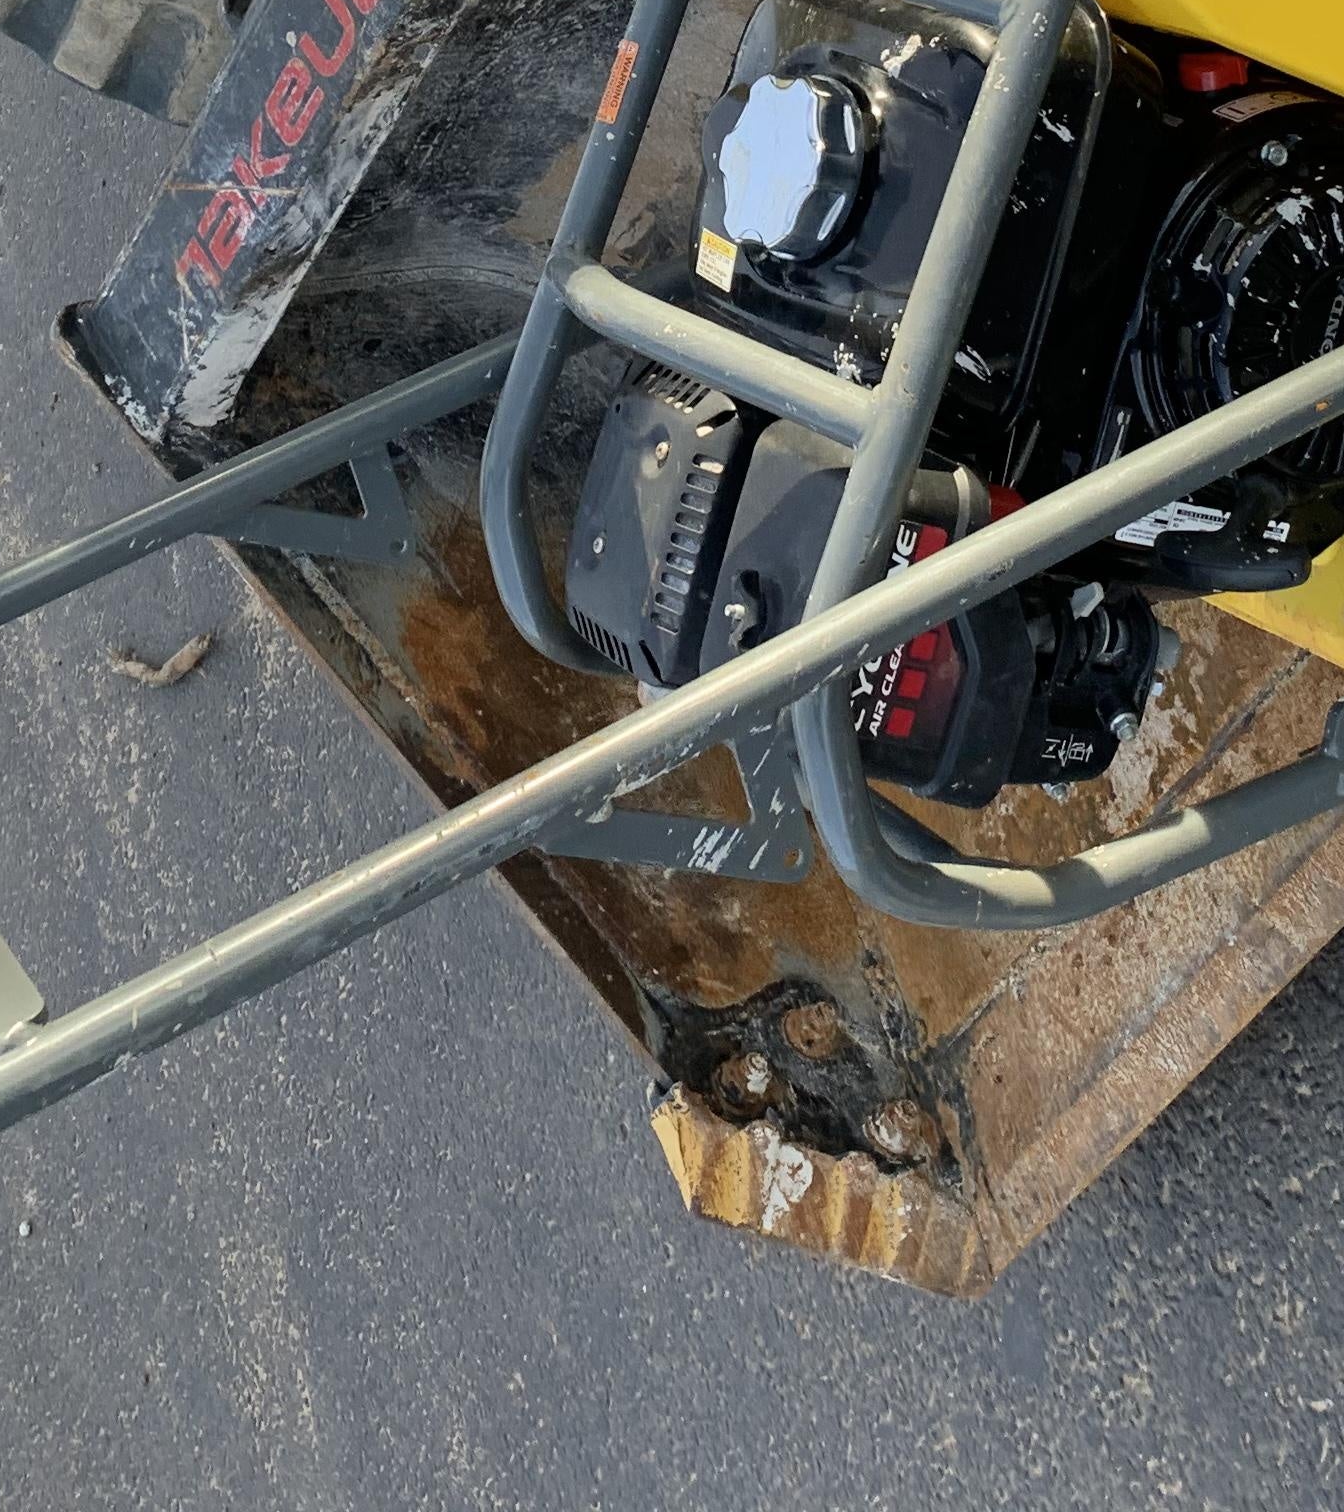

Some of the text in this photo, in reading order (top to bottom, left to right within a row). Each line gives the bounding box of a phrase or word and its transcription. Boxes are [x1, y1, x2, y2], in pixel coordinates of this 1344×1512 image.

[609, 56, 634, 109] WARNING
[867, 643, 905, 737] AIR CLEA
